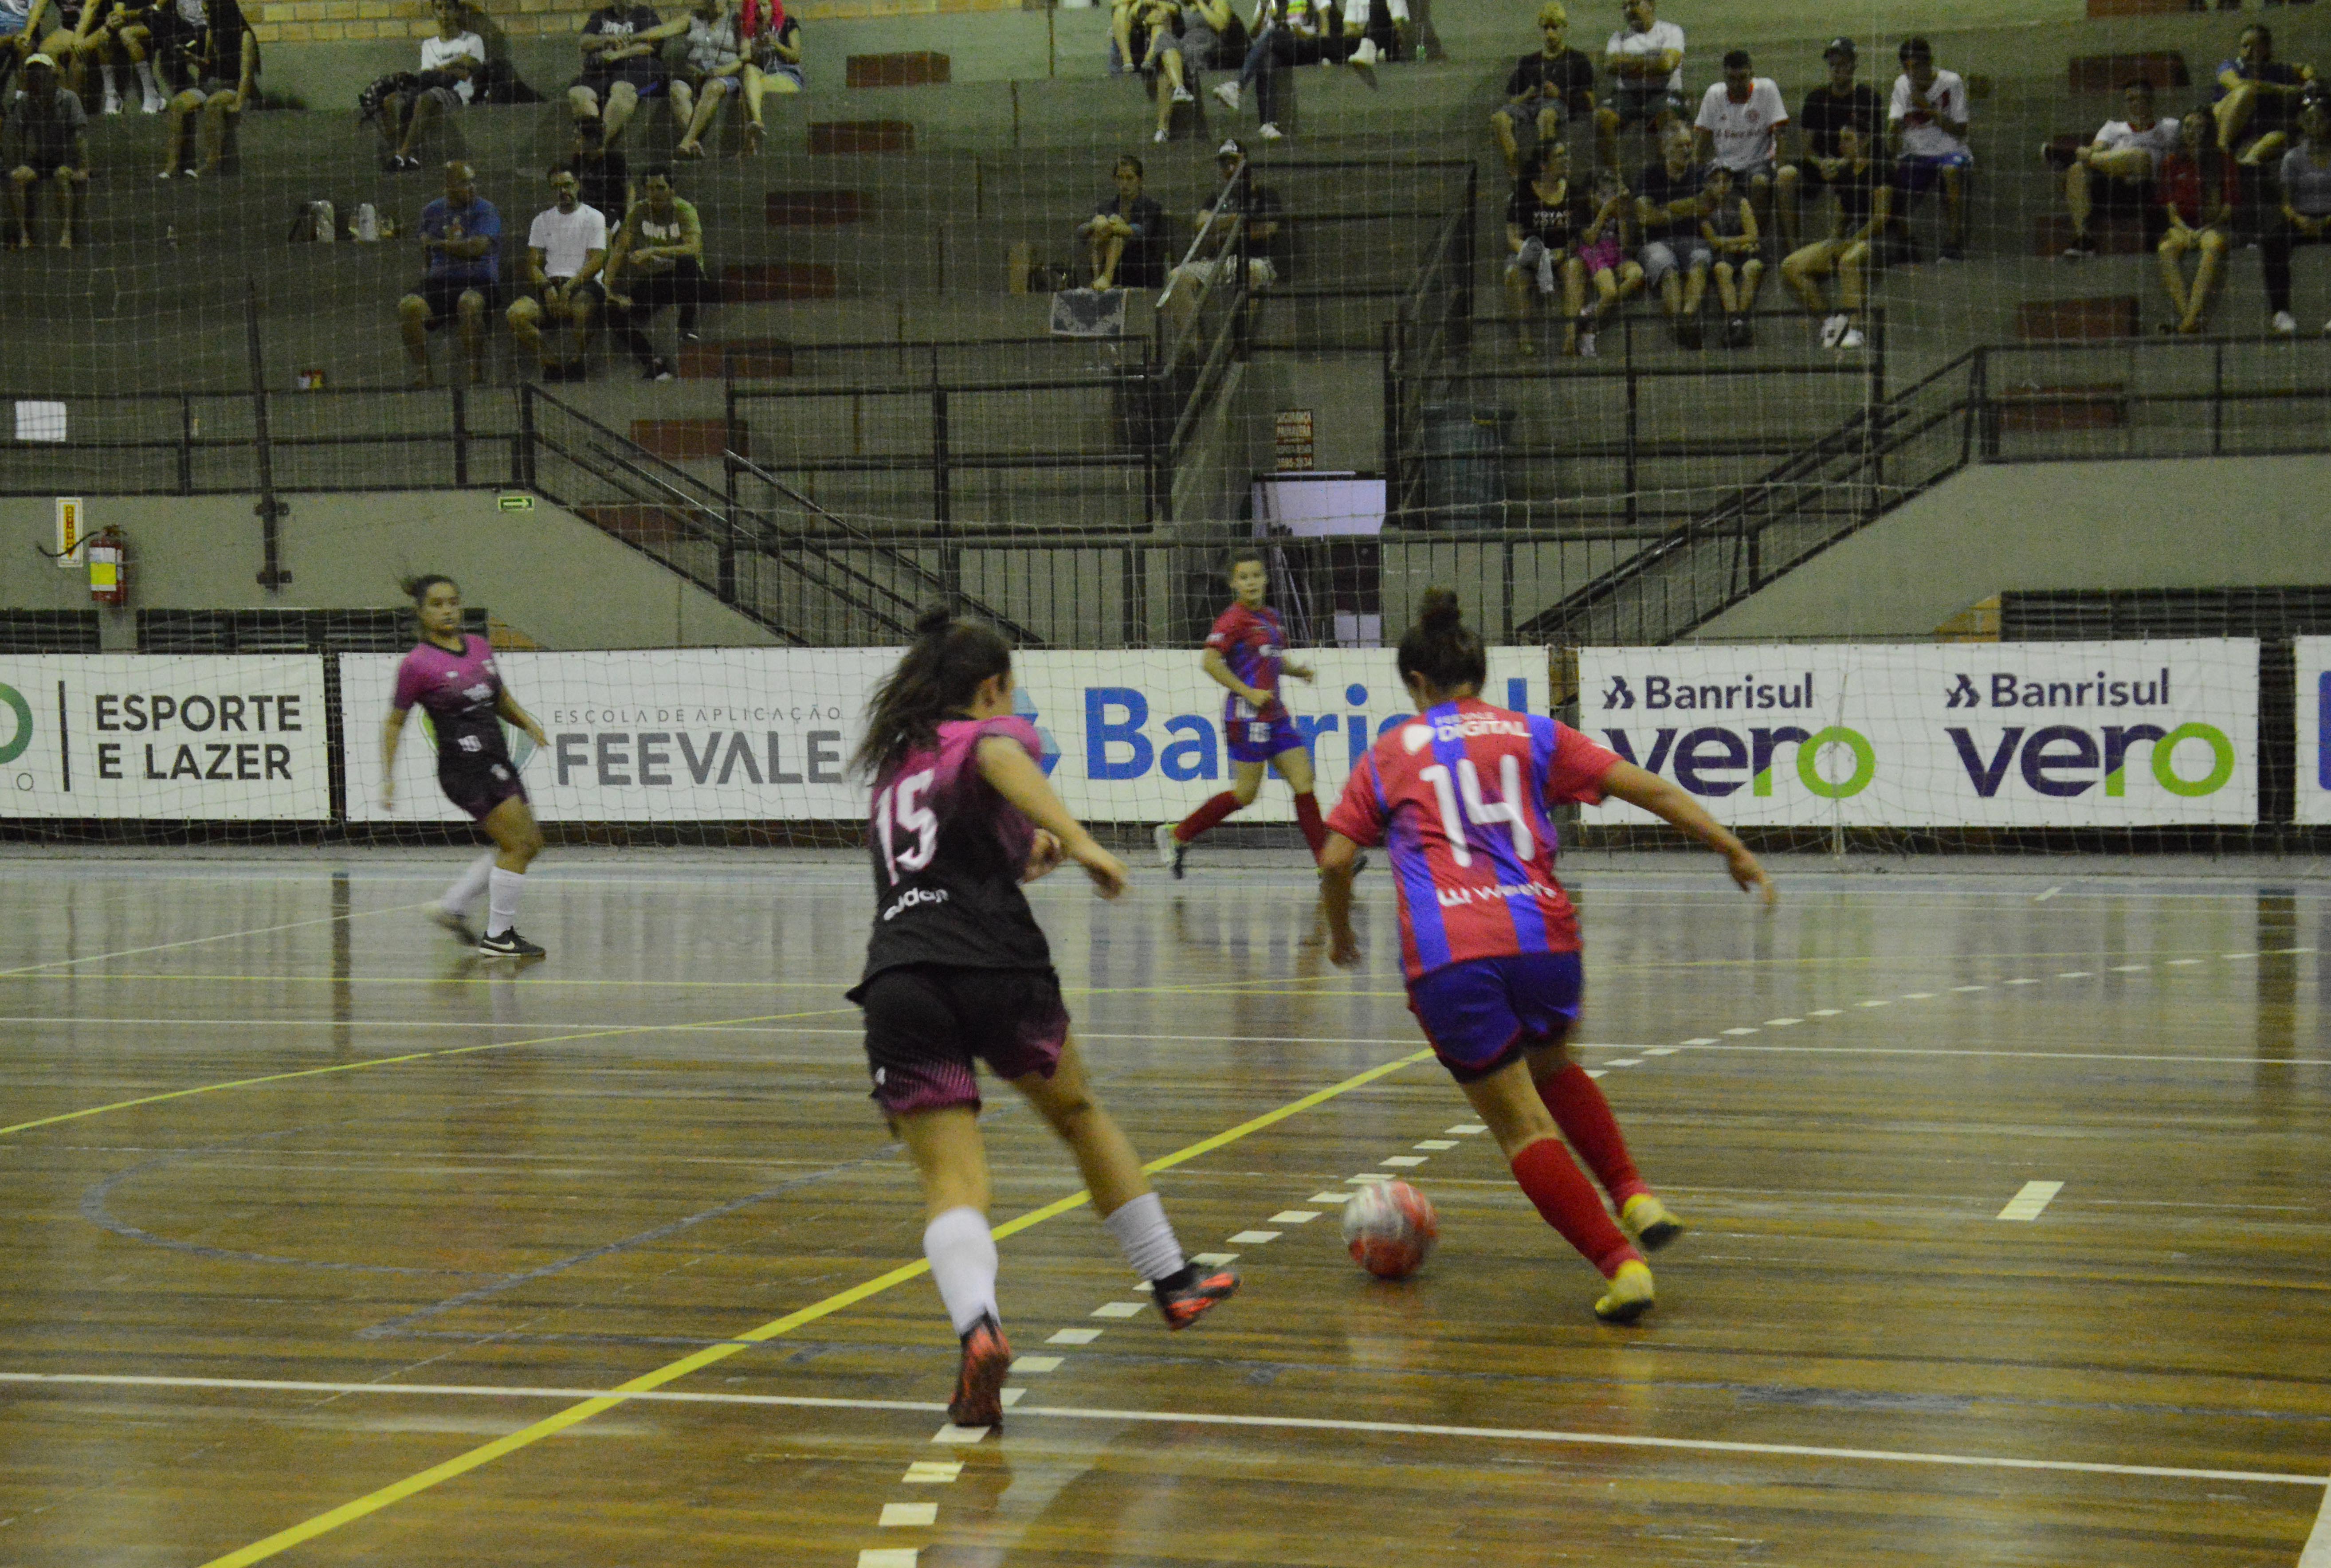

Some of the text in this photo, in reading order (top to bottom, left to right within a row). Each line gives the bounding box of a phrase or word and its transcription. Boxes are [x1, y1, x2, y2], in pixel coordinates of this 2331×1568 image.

[1646, 672, 1813, 710] Banrisul
[1992, 668, 2169, 708] Banrisul
[96, 694, 302, 732] ESPORTE
[554, 704, 842, 724] ESCOLA DE APLICAÇÃO
[1437, 720, 1532, 742] DIGITAL
[98, 744, 291, 780] E LAZER
[556, 730, 843, 786] FEEVALE
[1601, 726, 1876, 799] vero
[1945, 722, 2235, 797] vero
[876, 768, 939, 886] 15
[1419, 754, 1536, 867] 14
